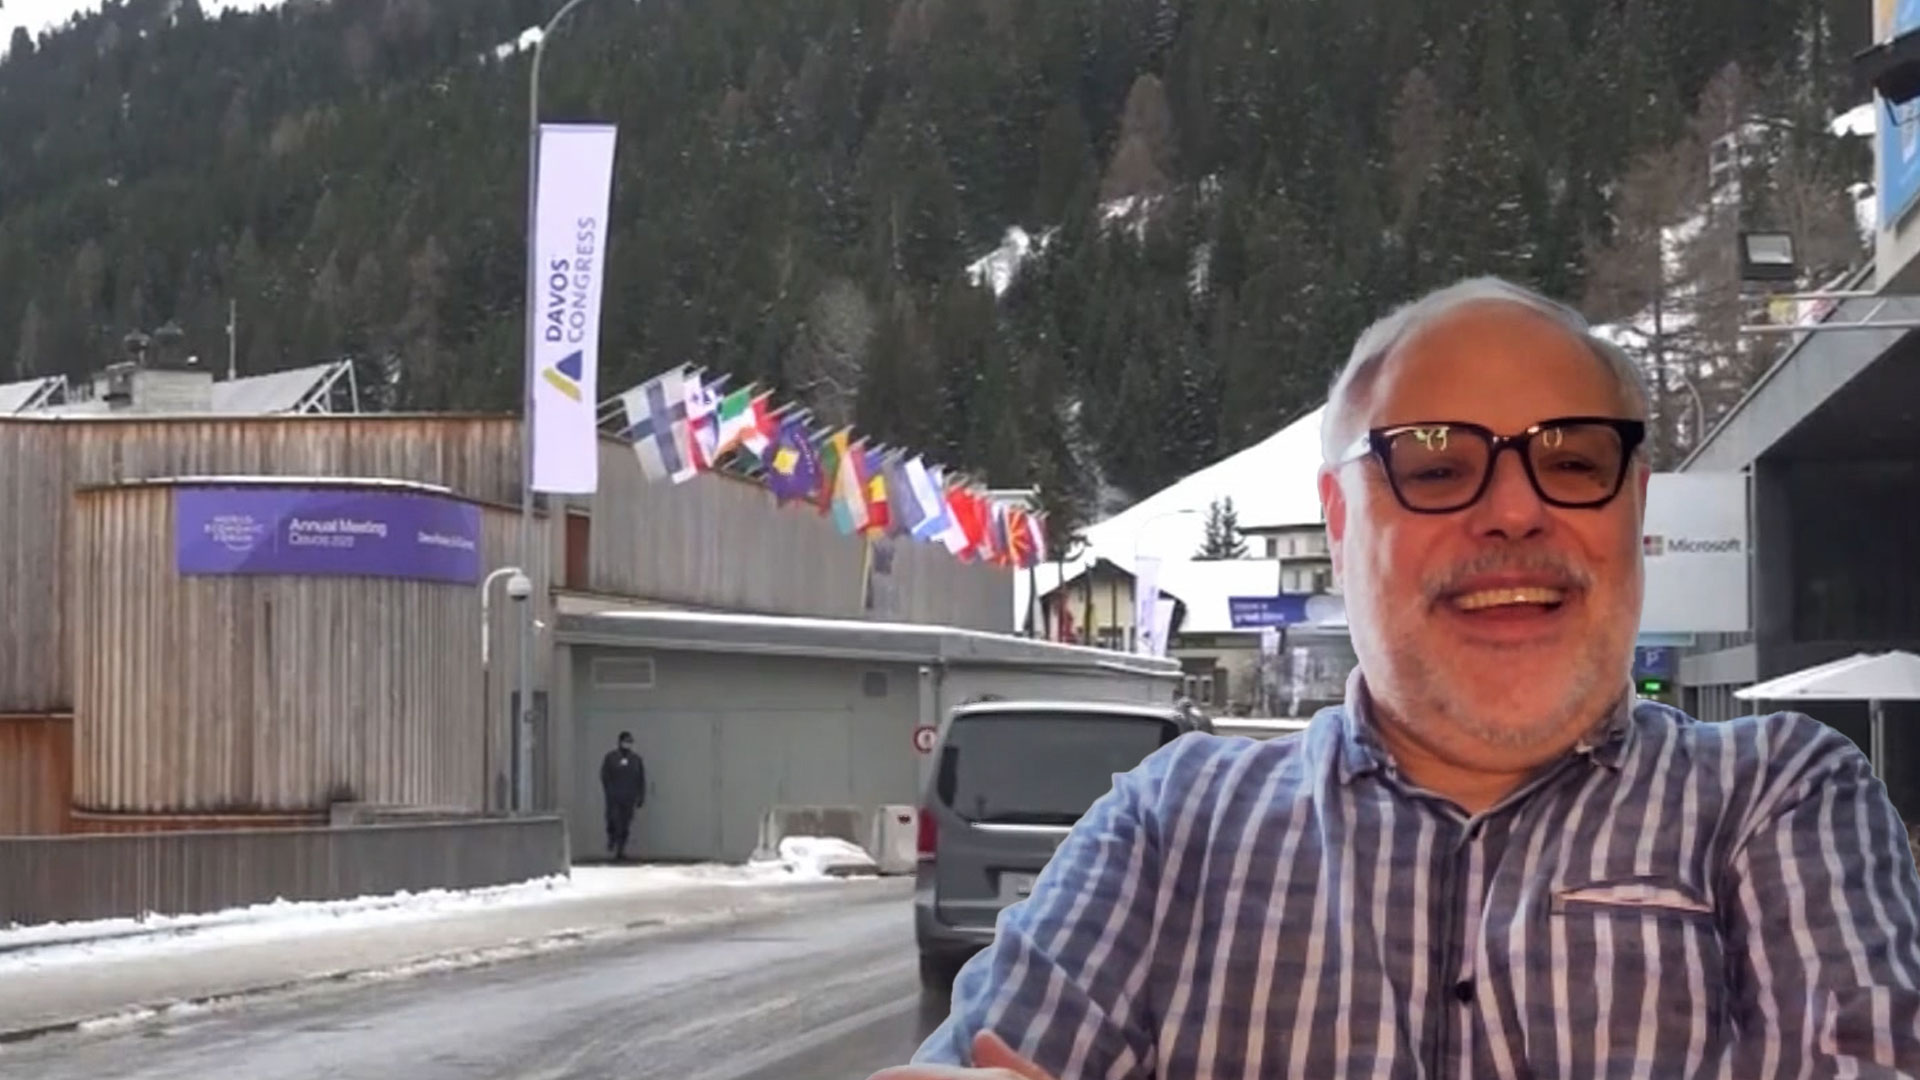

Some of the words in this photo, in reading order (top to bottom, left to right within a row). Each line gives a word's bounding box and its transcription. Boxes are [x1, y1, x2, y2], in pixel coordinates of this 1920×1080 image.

[545, 259, 570, 342] DAVOS
[567, 216, 596, 343] CONGRESS
[289, 517, 338, 532] Annual
[339, 518, 388, 538] Meeting
[1667, 538, 1741, 553] Microsoft
